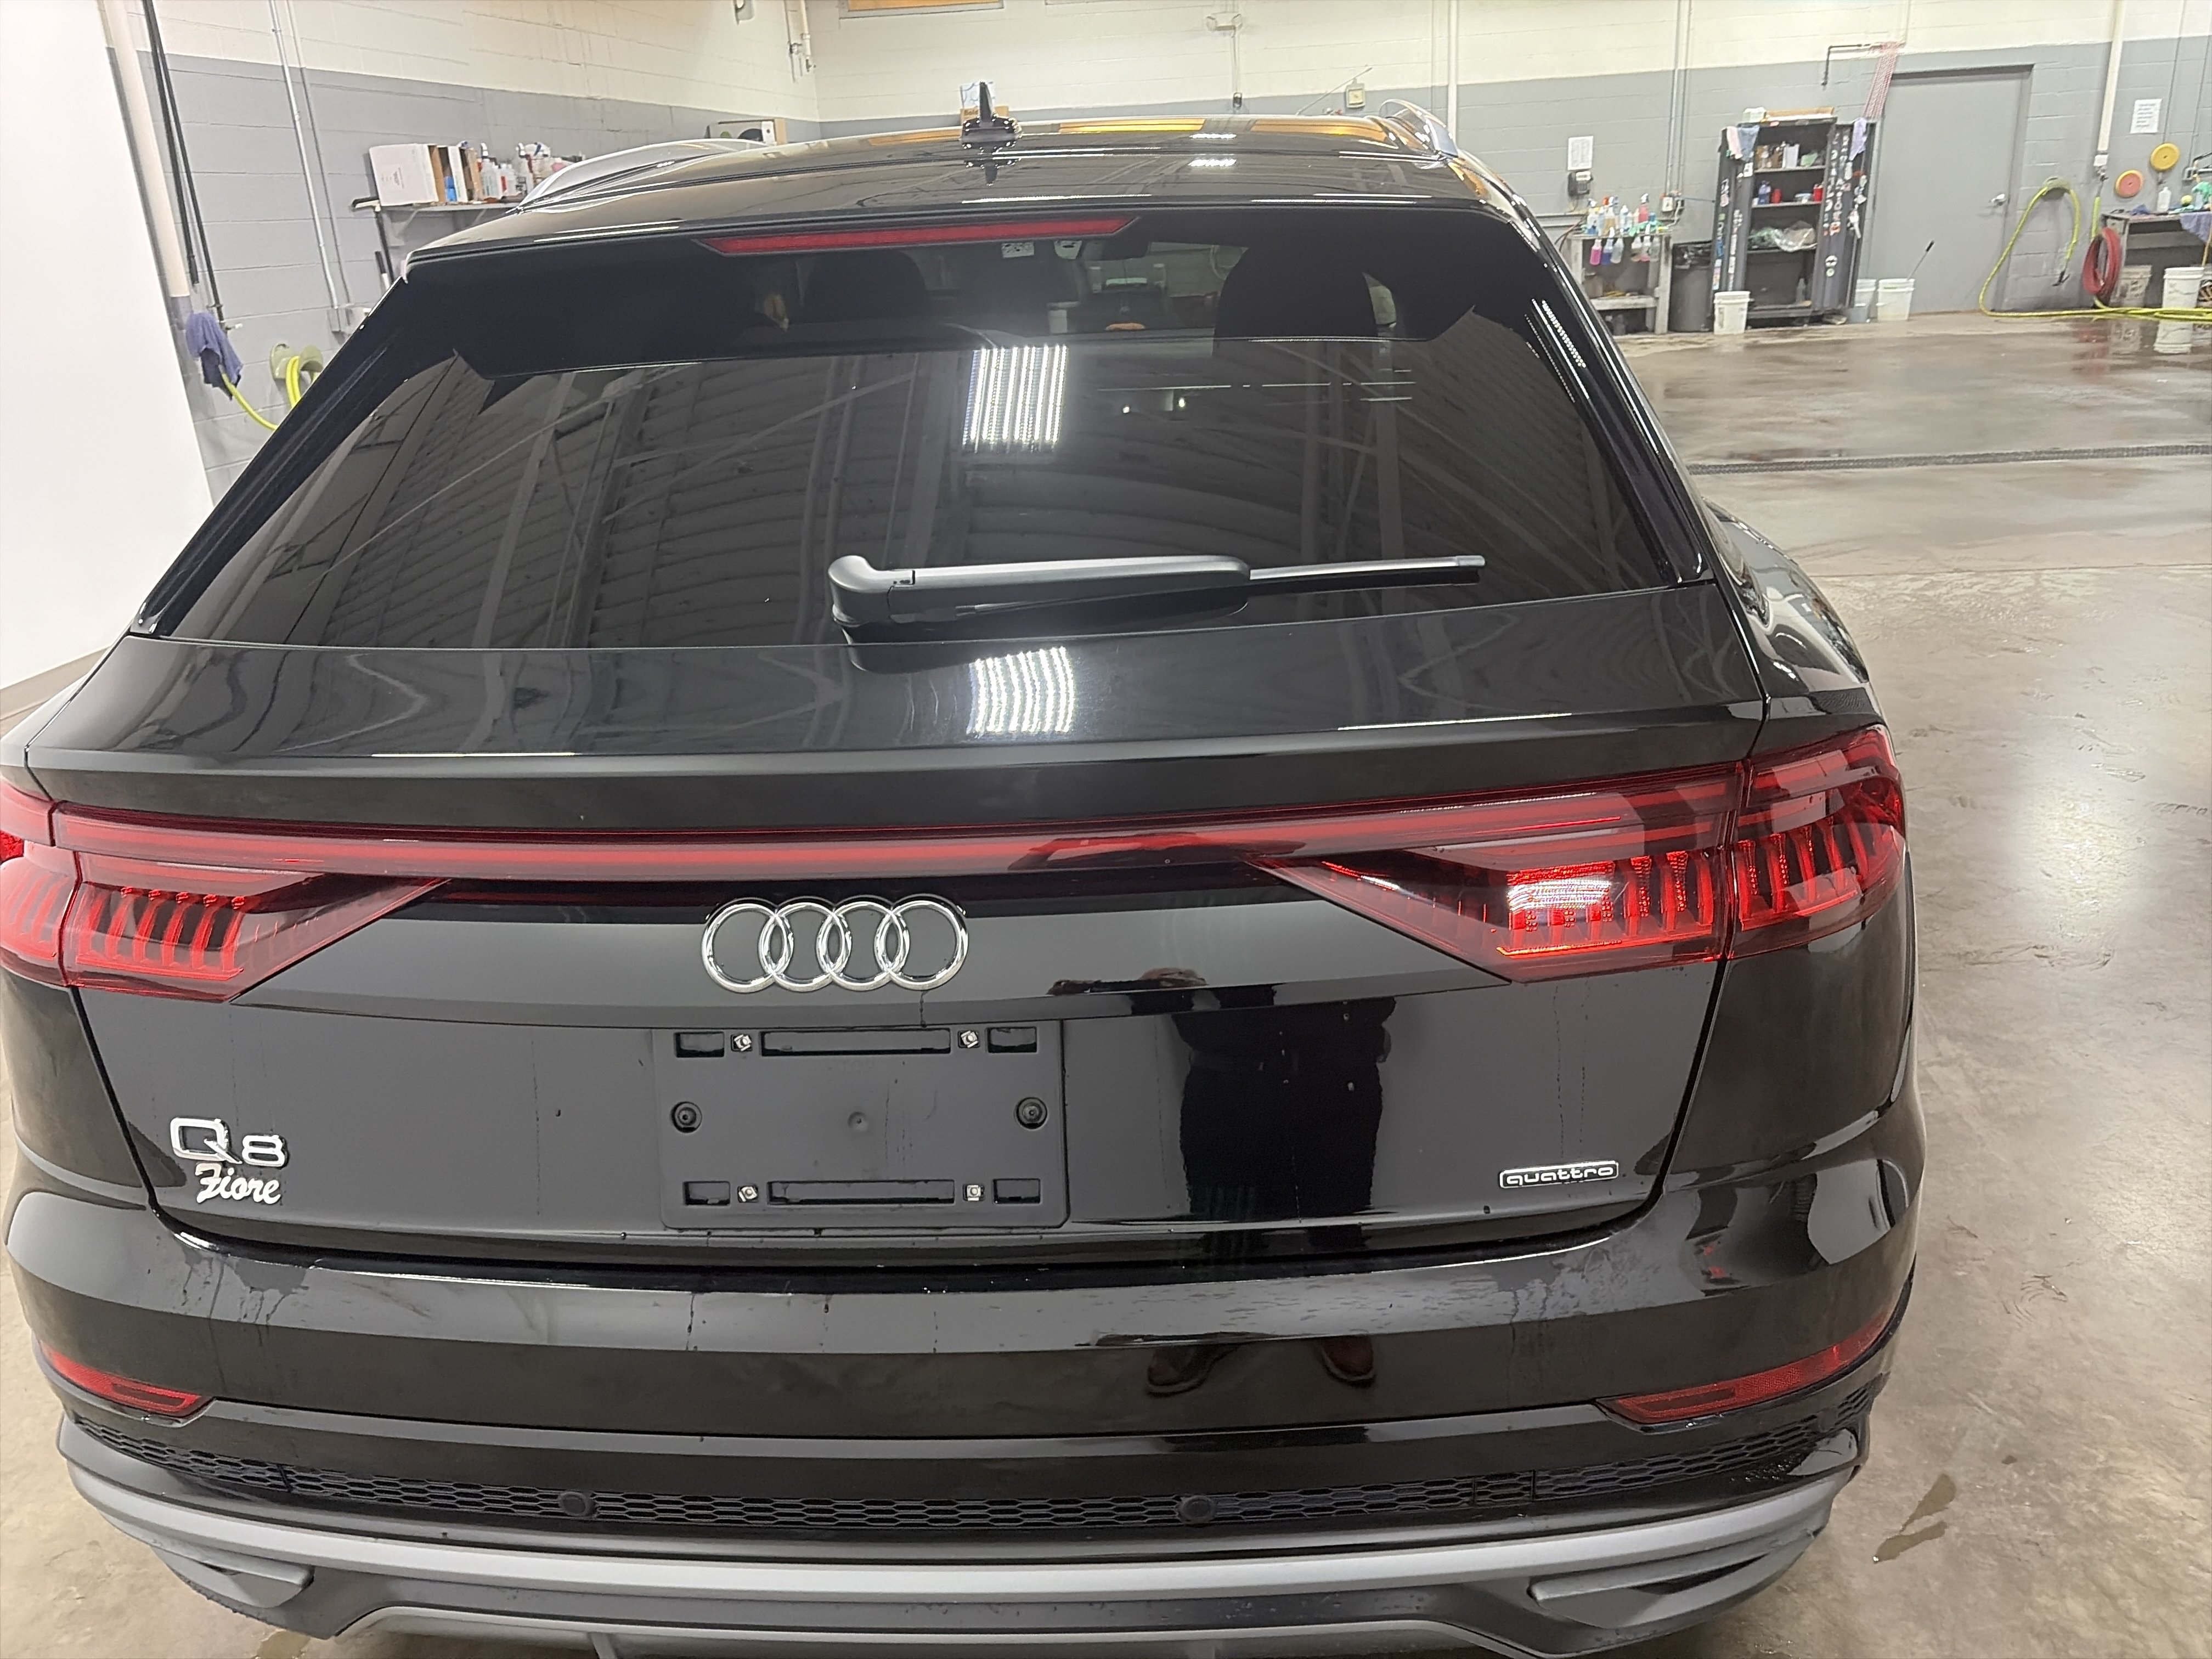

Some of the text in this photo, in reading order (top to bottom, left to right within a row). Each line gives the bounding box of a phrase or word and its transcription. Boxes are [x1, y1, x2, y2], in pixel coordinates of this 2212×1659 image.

[170, 1117, 286, 1167] Q8
[195, 1163, 281, 1204] Fiore
[1506, 1167, 1613, 1186] quattro
